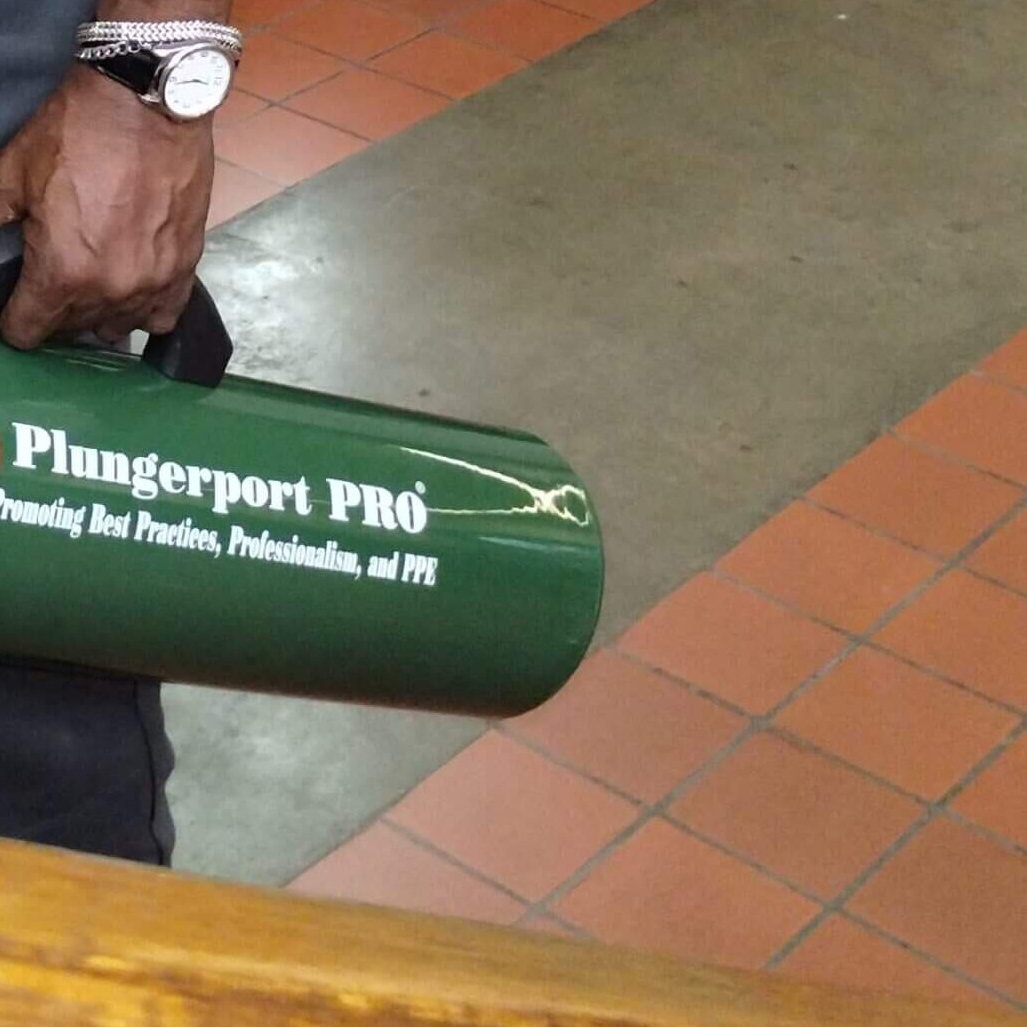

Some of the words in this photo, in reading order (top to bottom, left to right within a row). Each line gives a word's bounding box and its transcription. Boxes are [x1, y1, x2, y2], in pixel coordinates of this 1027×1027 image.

[11, 421, 312, 516] Plungerport
[88, 503, 131, 538] Best
[134, 510, 221, 558] Practices,
[227, 524, 362, 579] Professionalism,
[367, 551, 399, 580] and
[401, 553, 439, 586] PPE
